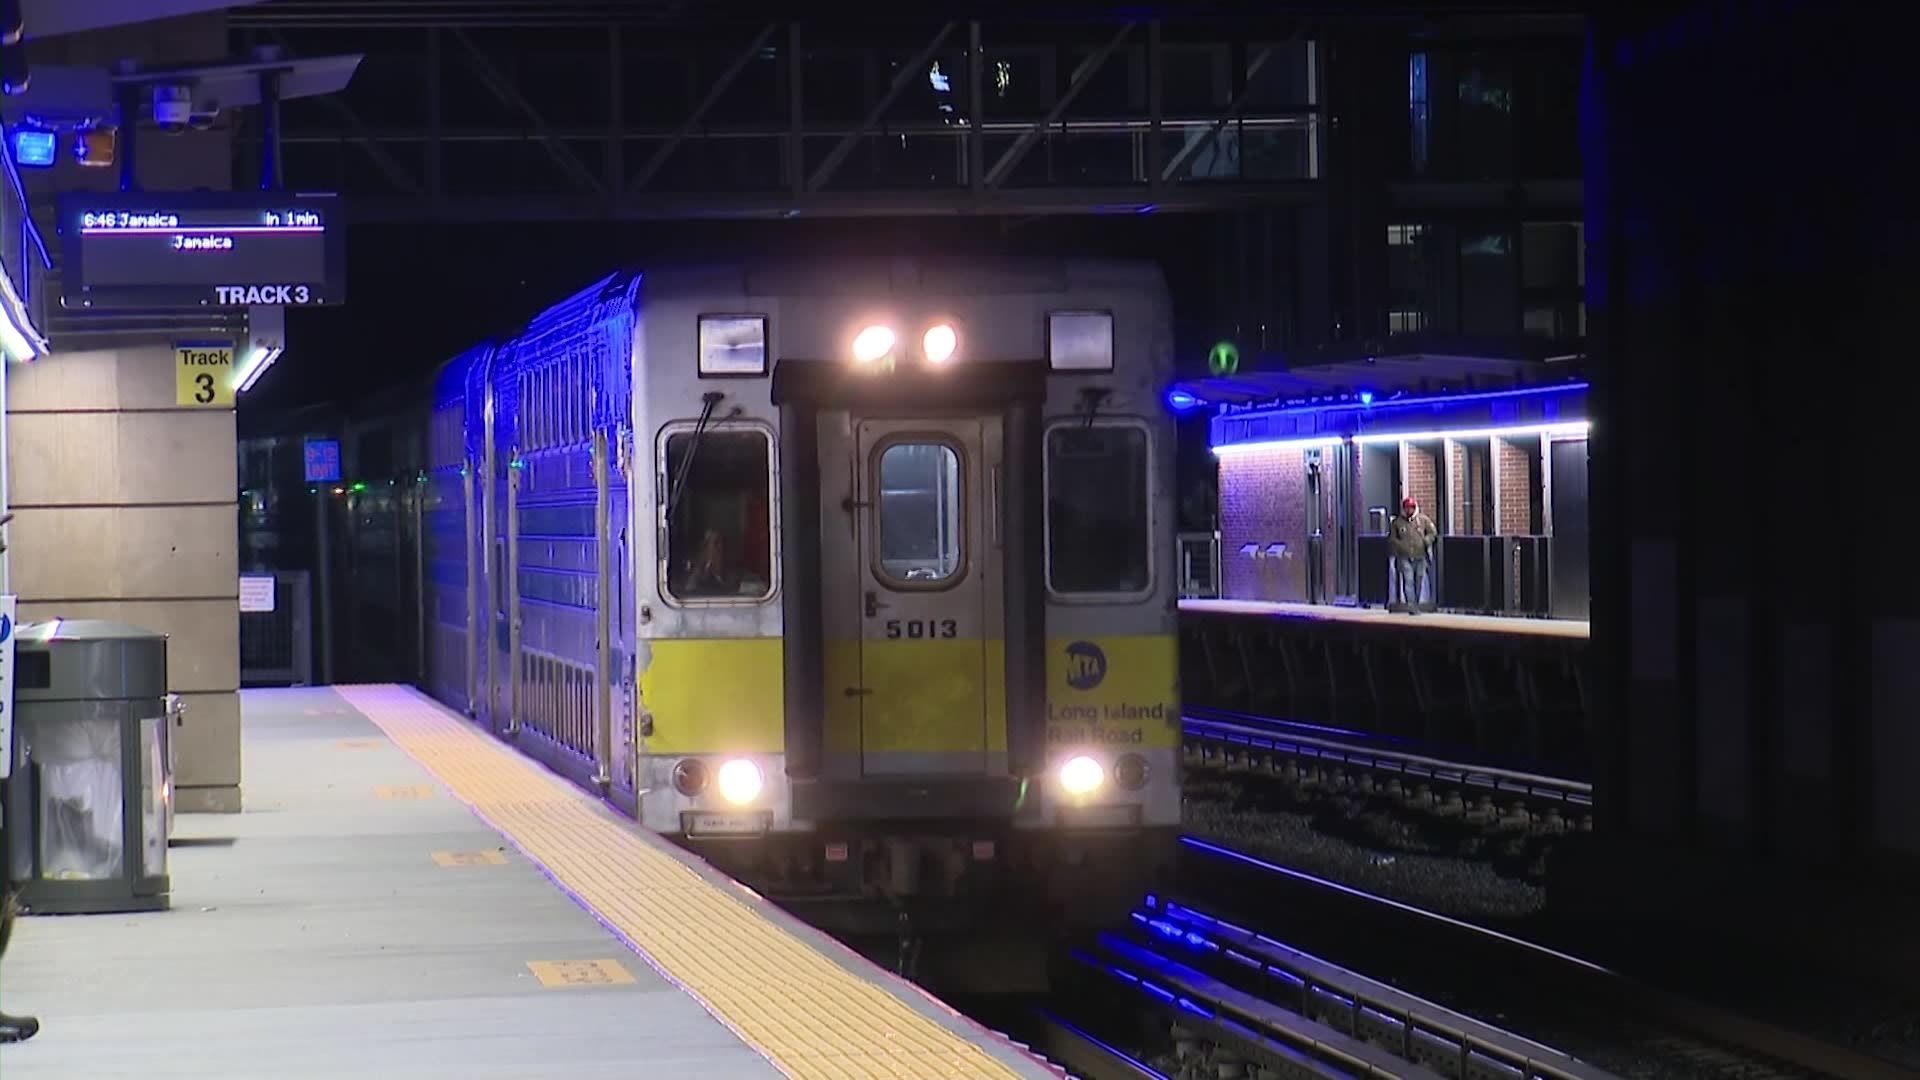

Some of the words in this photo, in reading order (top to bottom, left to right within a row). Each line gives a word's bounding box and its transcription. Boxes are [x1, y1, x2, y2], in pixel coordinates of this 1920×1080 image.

[84, 212, 116, 227] 6:46
[119, 211, 178, 227] Jamaica
[174, 234, 232, 249] Jamaica
[215, 285, 292, 304] TRACK
[294, 285, 309, 304] 3
[180, 349, 229, 366] Track
[194, 373, 216, 404] 3
[885, 619, 958, 639] 5013
[1064, 651, 1101, 681] MTA
[1047, 703, 1097, 722] Long
[1103, 702, 1163, 719] Island
[1092, 727, 1143, 743] Road
